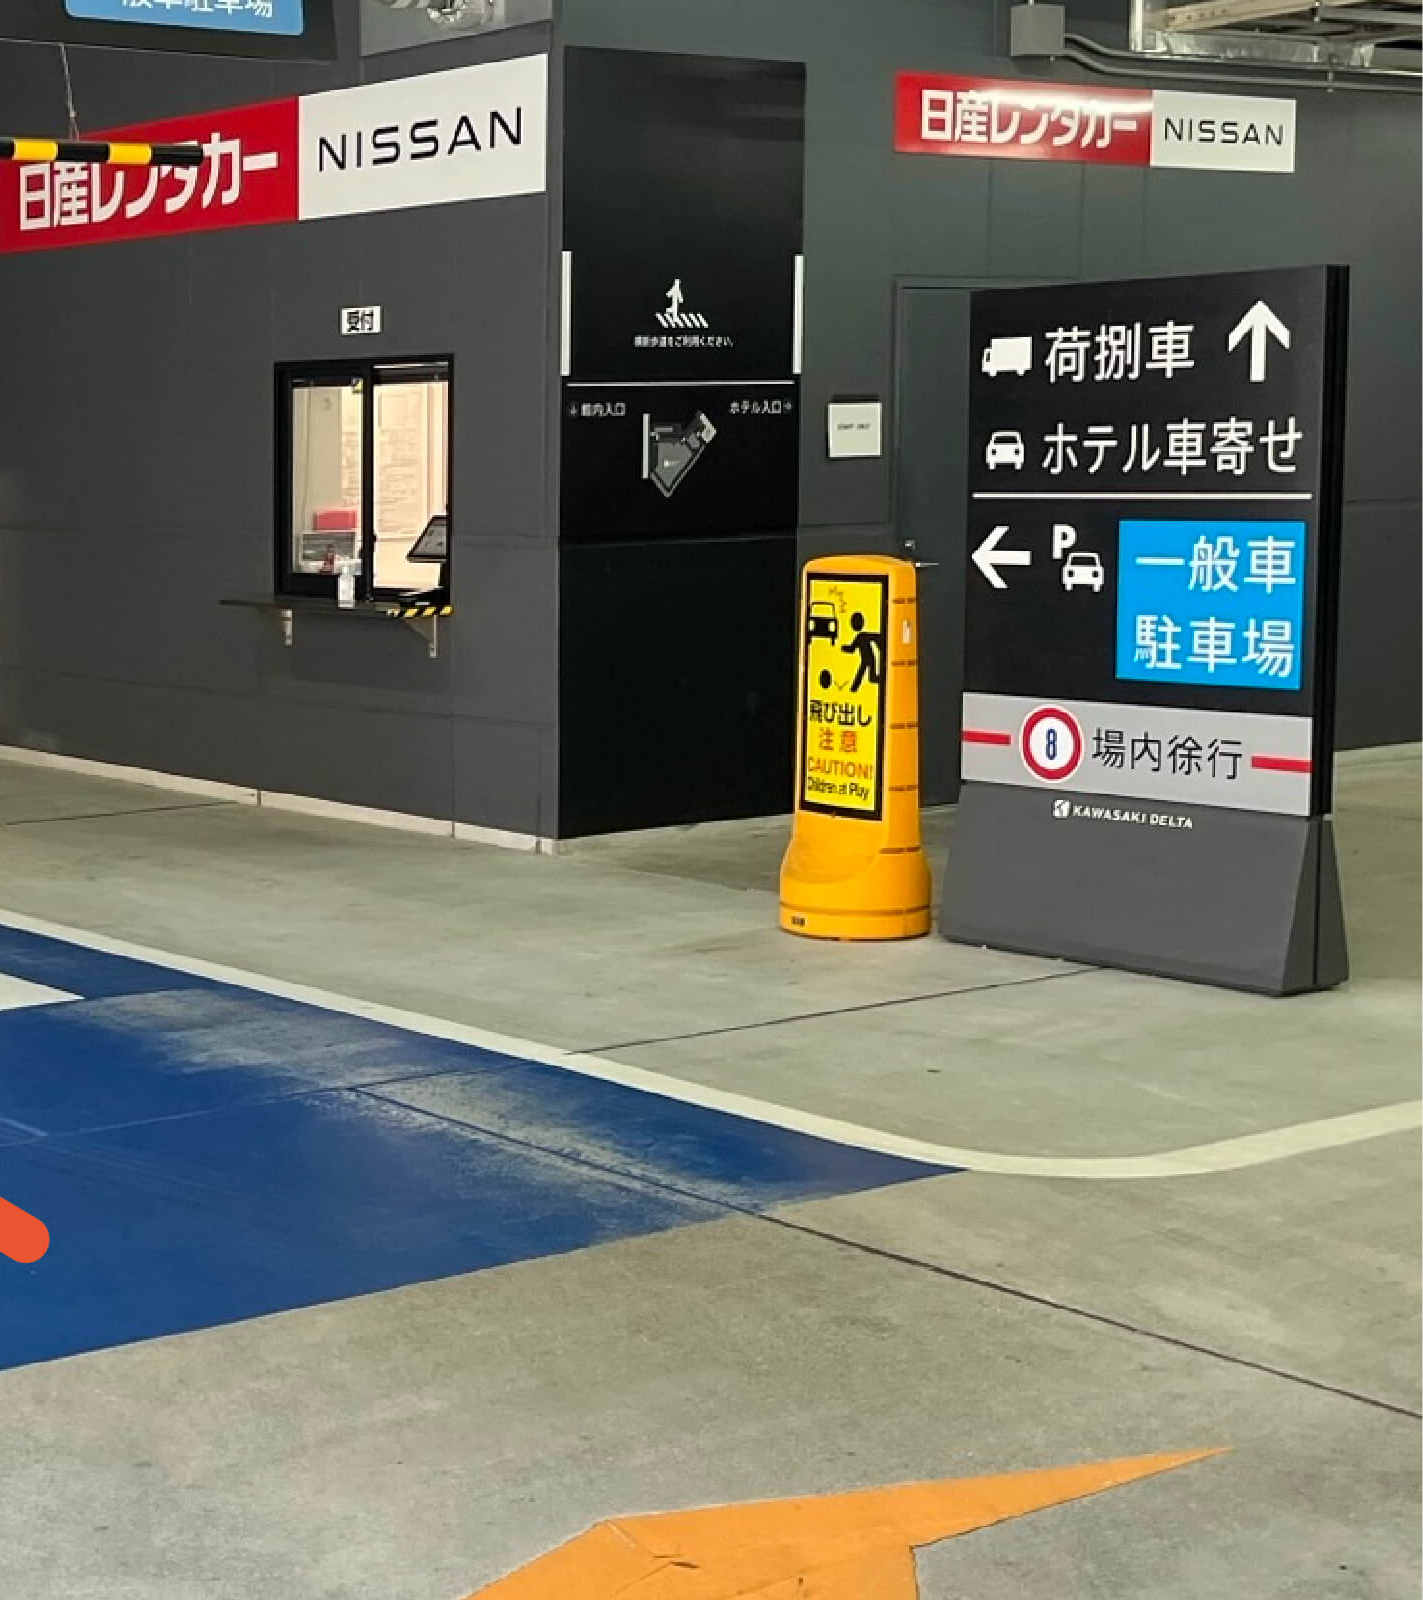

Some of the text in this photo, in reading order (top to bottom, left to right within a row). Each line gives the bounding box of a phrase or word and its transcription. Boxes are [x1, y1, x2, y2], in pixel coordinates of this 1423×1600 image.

[318, 106, 522, 172] NISSAN
[921, 88, 1138, 149] 日産レンタカー
[1164, 117, 1284, 147] NISSAN
[1044, 319, 1196, 384] 荷捌車
[1041, 415, 1304, 476] ホテル車寄せ
[1134, 534, 1298, 595] 一般車
[1133, 613, 1296, 680] 駐車場
[808, 756, 874, 780] CAUTION!
[1045, 727, 1058, 761] 8
[1090, 726, 1244, 781] 場内徐行
[1072, 804, 1194, 829] KAWASAKI DELTA
